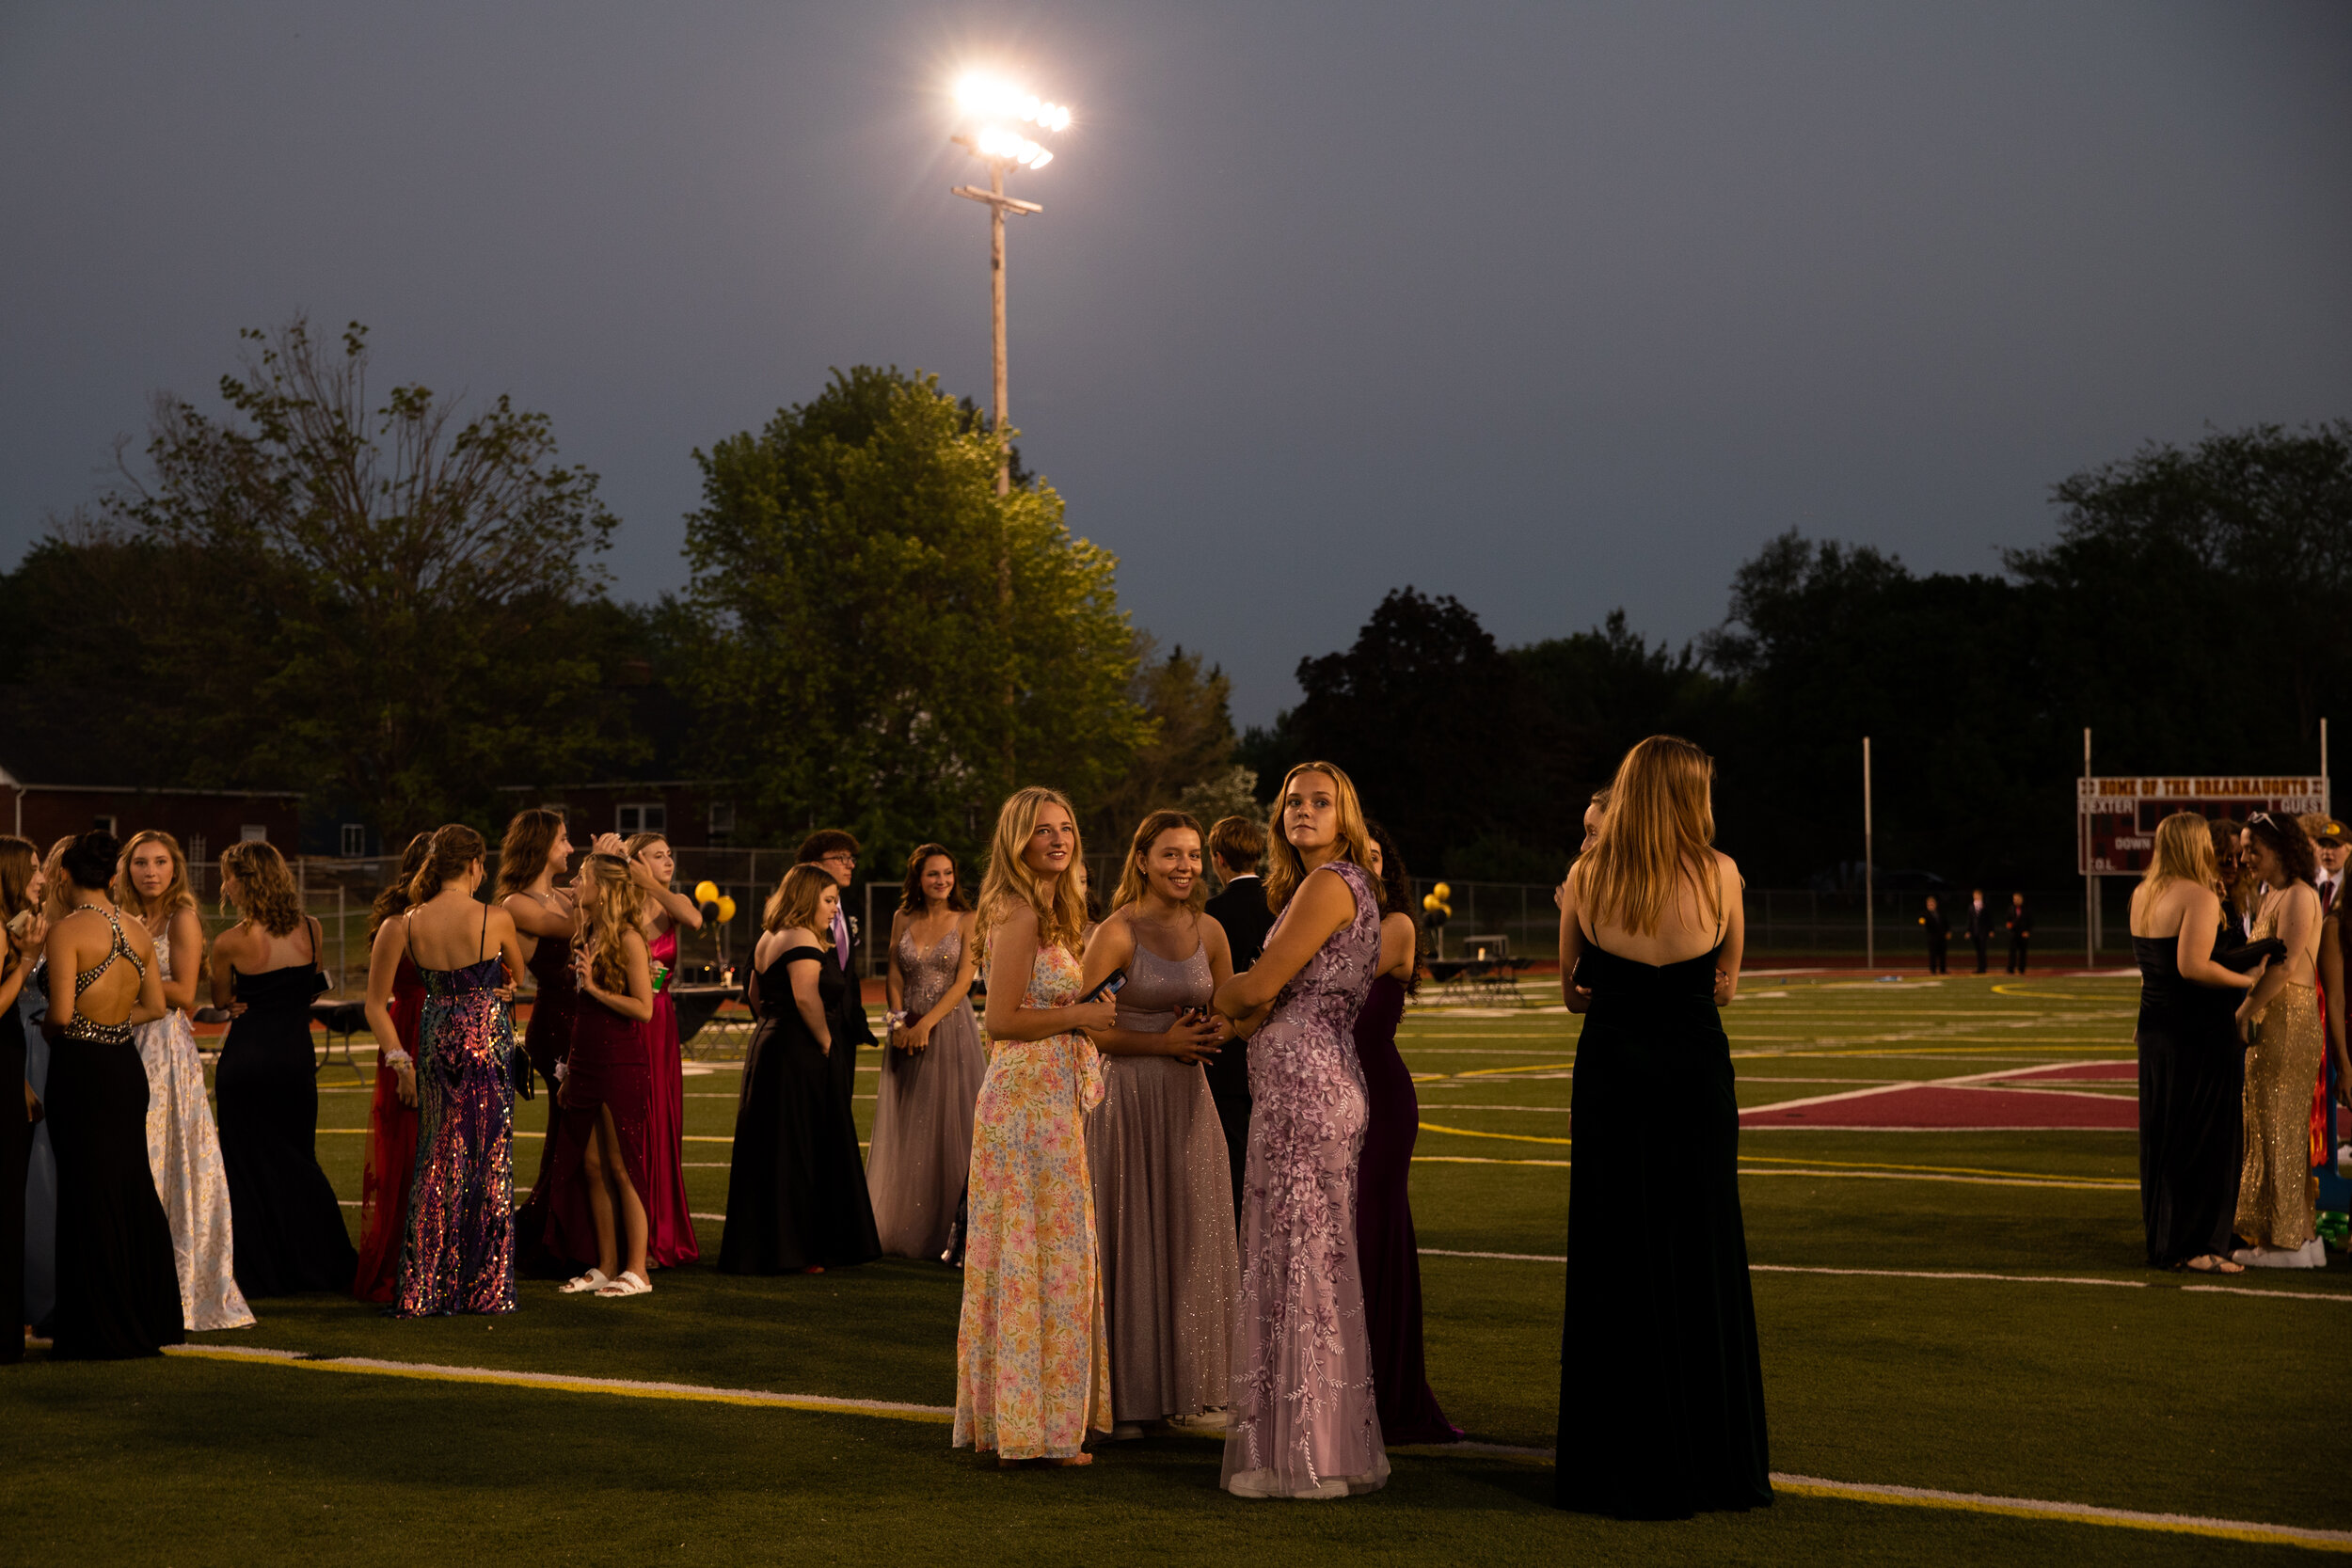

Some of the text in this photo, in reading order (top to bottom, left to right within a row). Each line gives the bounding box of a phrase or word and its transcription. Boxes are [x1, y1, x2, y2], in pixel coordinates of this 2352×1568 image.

[2099, 780, 2309, 797] HOME OF THE DREADNAUGHTS
[2114, 837, 2152, 850] DOWN
